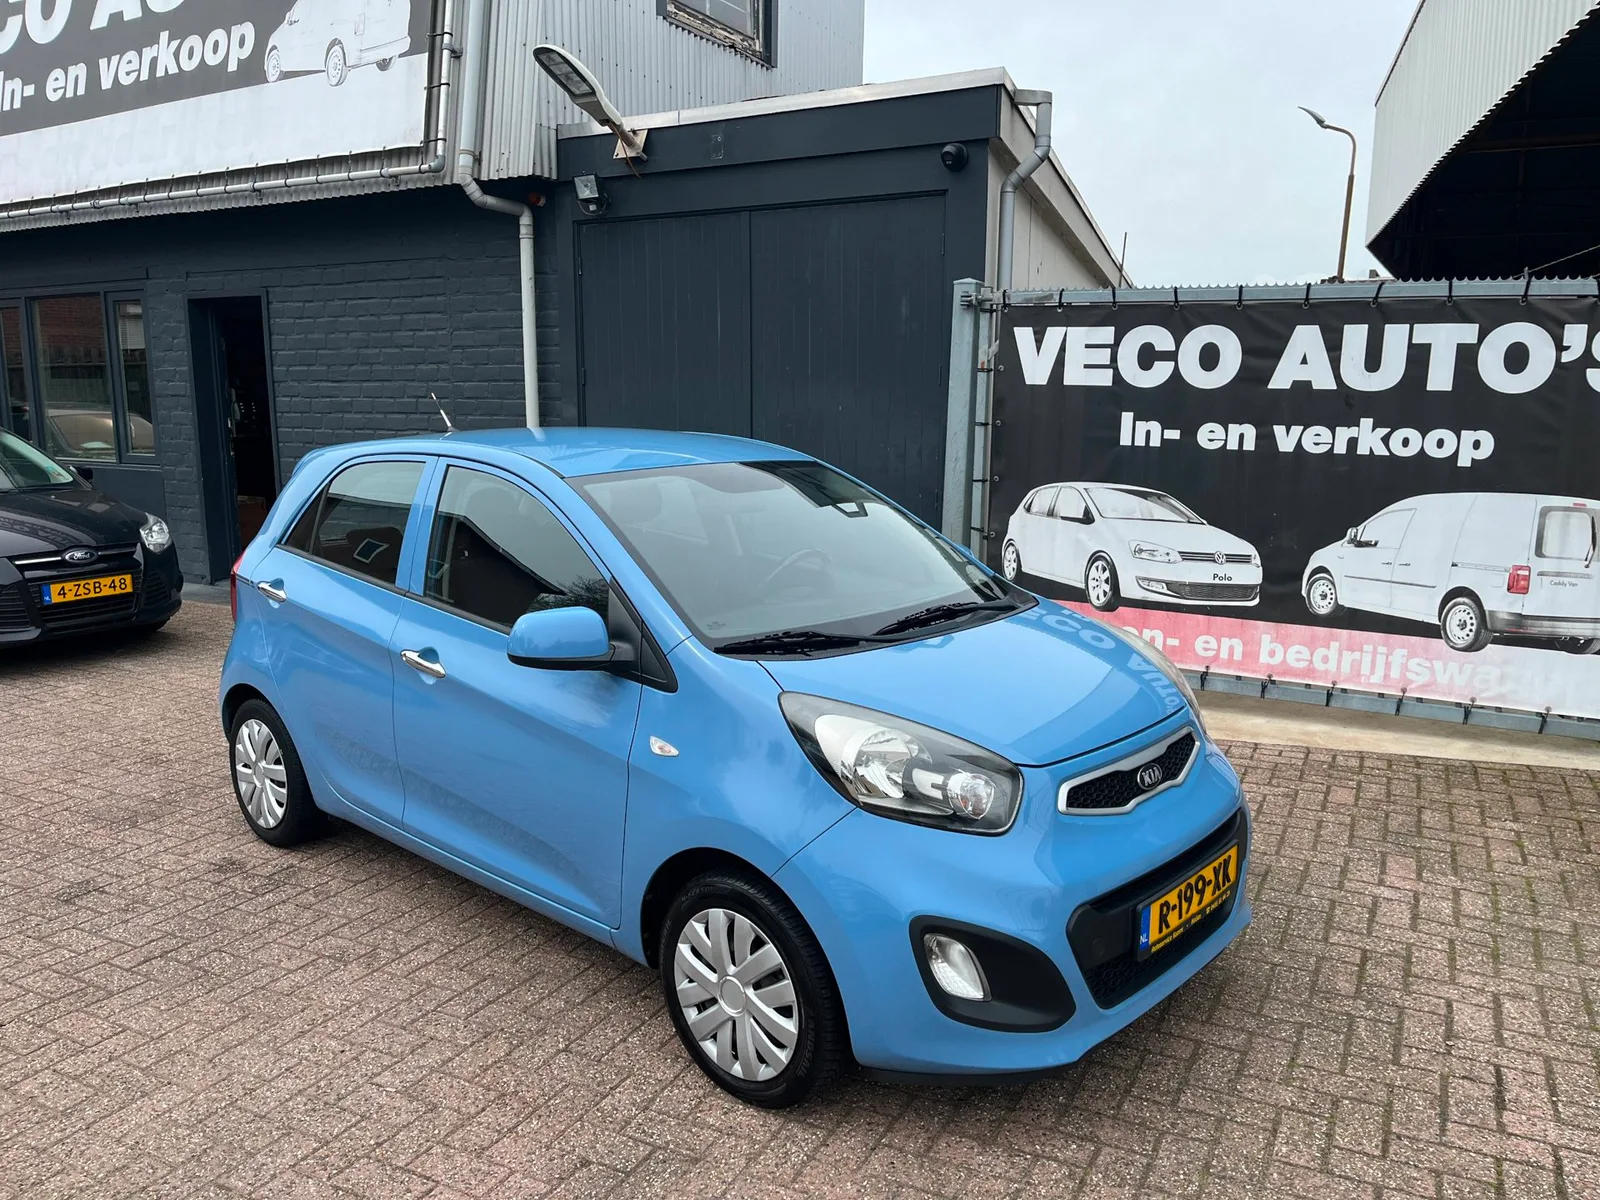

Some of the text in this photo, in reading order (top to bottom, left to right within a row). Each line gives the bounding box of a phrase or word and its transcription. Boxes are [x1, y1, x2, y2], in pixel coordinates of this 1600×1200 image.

[46, 62, 87, 102] en
[99, 21, 255, 91] verkoop
[1013, 324, 1243, 389] VECO
[1119, 411, 1495, 467] In- en verkoop
[57, 577, 127, 599] 4-ZSB-48
[1212, 572, 1233, 582] Polo
[1194, 634, 1245, 660] en
[1141, 766, 1161, 787] KIA
[1158, 854, 1232, 934] R-199-XK
[1140, 932, 1148, 944] NL
